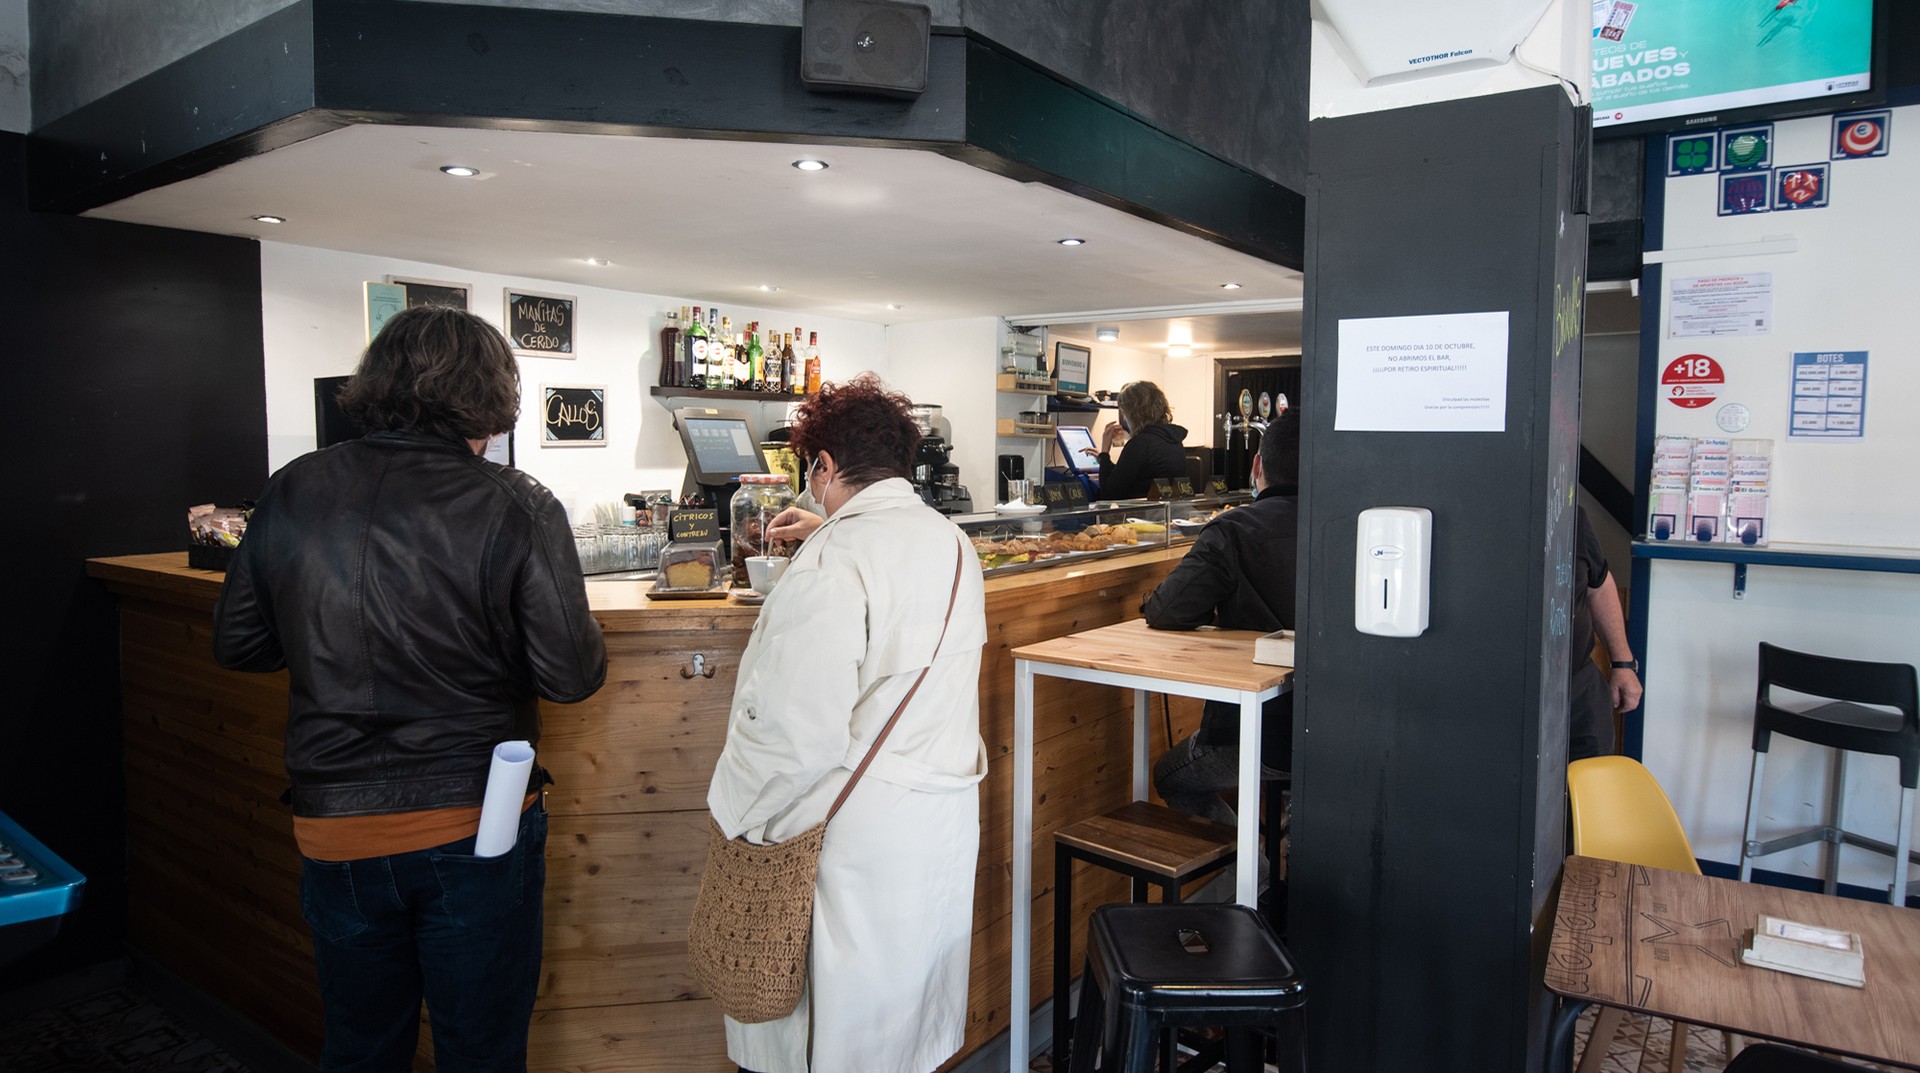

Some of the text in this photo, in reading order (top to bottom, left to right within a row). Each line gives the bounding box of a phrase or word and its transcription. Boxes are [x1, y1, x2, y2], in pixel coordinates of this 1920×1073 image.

[1630, 40, 1647, 50] DE
[1408, 49, 1473, 65] VECTOTHOR Falcon
[1686, 116, 1718, 125] SAMSUNG
[533, 322, 547, 333] DE
[521, 333, 559, 349] CERDO
[1444, 342, 1476, 350] OCTUBRE,
[1817, 354, 1844, 363] BOTES
[1397, 365, 1419, 373] RETIRO
[1673, 358, 1711, 378] +18
[546, 394, 600, 431] CALLOS
